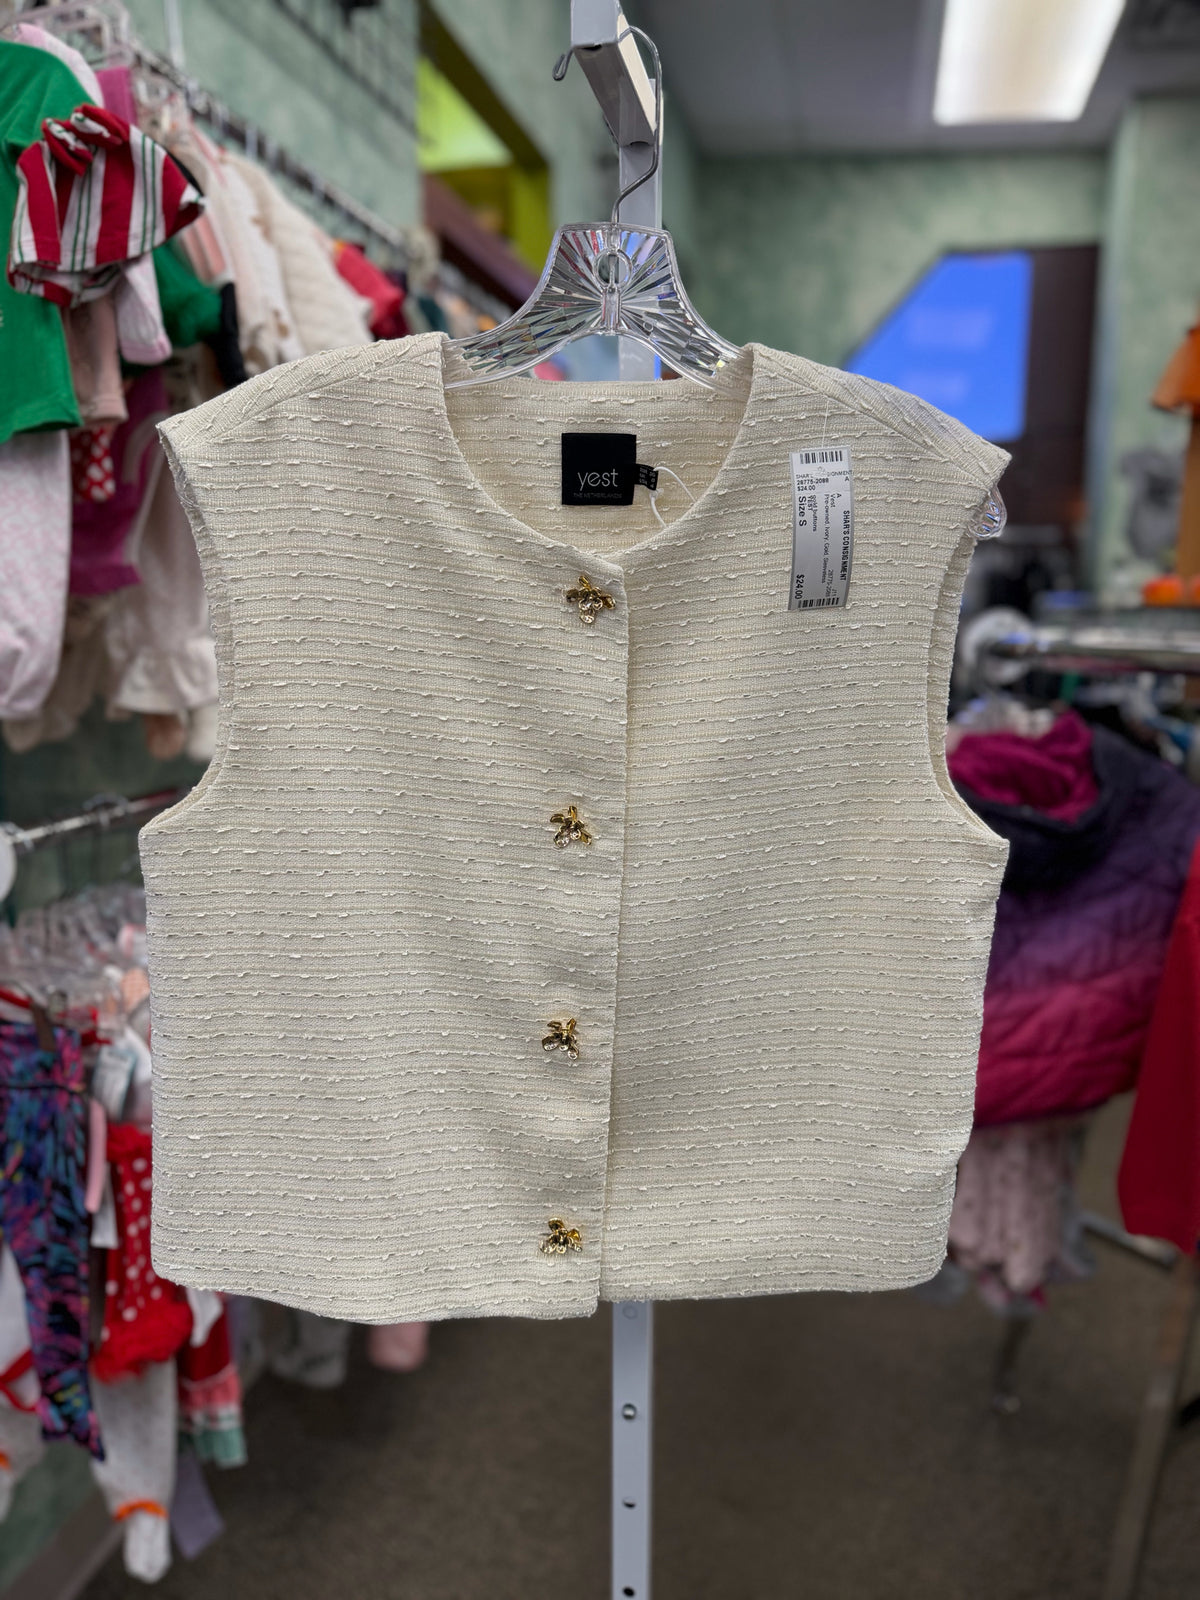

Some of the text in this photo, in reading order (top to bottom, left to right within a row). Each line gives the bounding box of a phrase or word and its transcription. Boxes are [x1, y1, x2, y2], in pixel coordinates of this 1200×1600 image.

[577, 468, 618, 491] yest
[798, 496, 807, 527] Size S
[840, 510, 851, 581] SHAR'S CONSIGNMENT
[793, 574, 805, 600] $24.00
